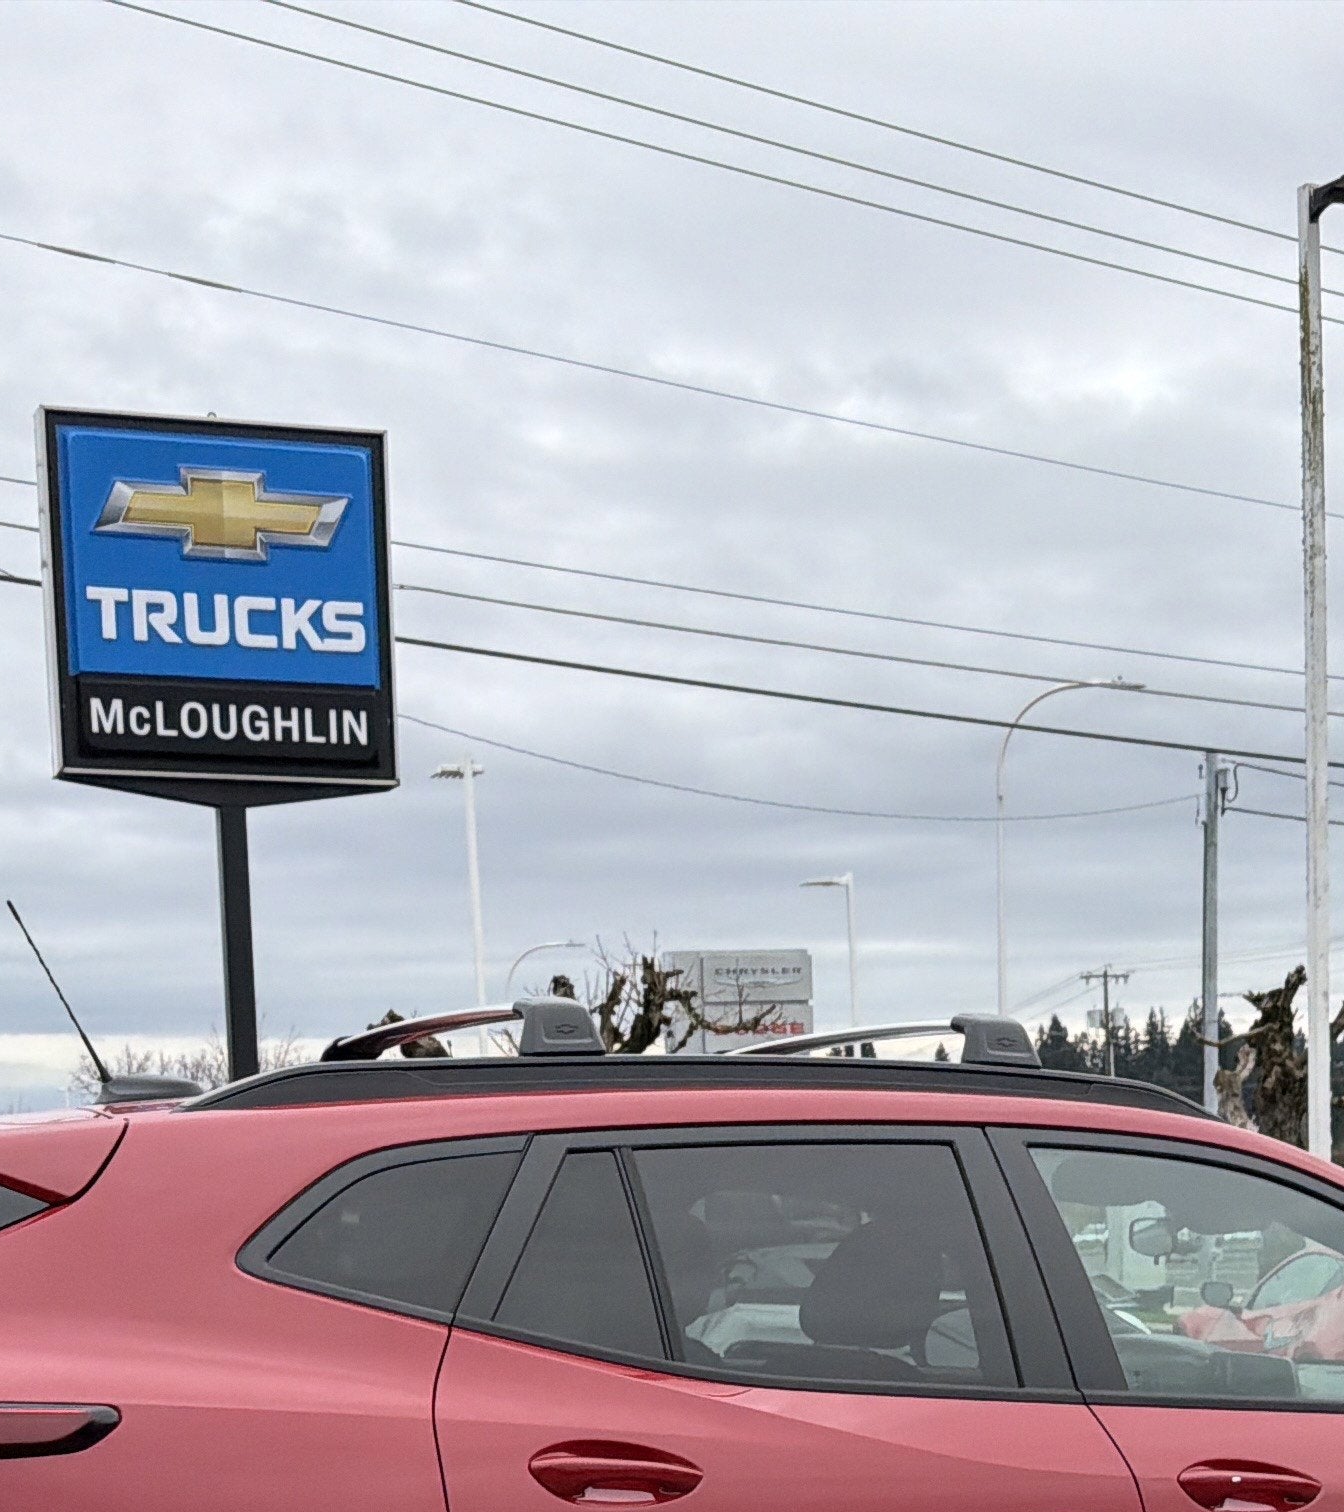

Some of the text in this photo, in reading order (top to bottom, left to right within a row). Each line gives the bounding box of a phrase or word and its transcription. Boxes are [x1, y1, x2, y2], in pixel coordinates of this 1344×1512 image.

[85, 585, 367, 653] TRUCKS
[89, 697, 368, 746] McLOUGHLIN
[715, 967, 802, 976] CHRYSLER
